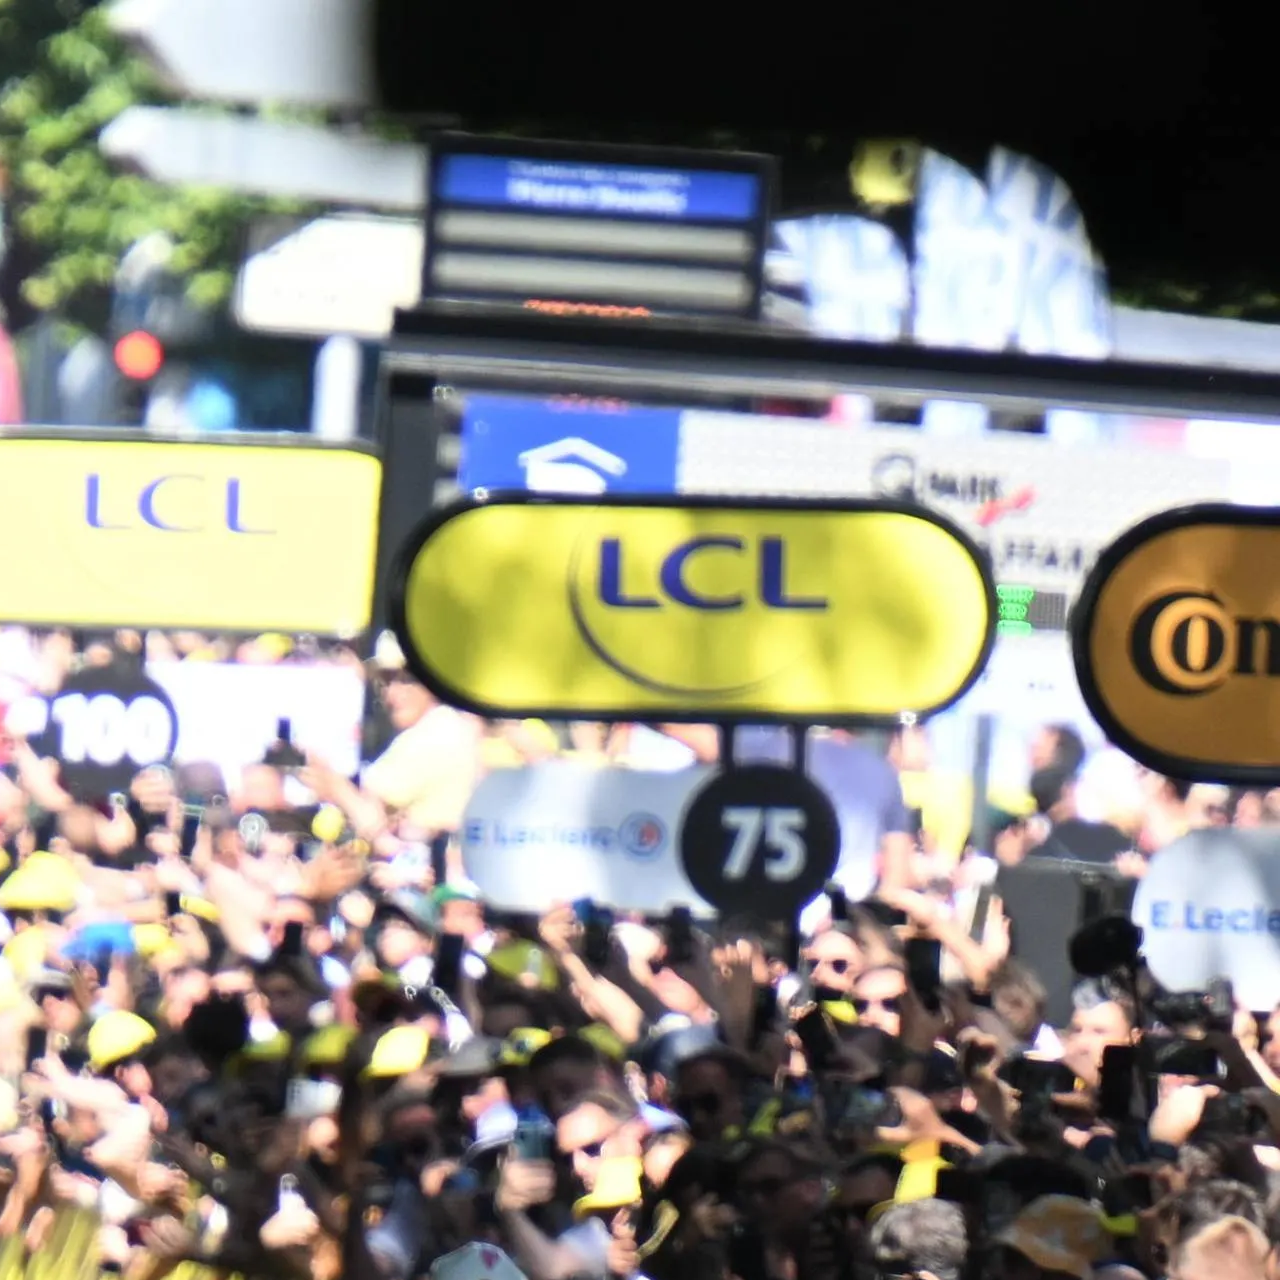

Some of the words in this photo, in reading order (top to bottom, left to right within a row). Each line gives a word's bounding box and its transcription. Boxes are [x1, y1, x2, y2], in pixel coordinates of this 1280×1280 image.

[86, 474, 278, 535] LCL
[599, 535, 827, 609] LCL
[51, 692, 172, 765] 100
[721, 806, 808, 882] 75
